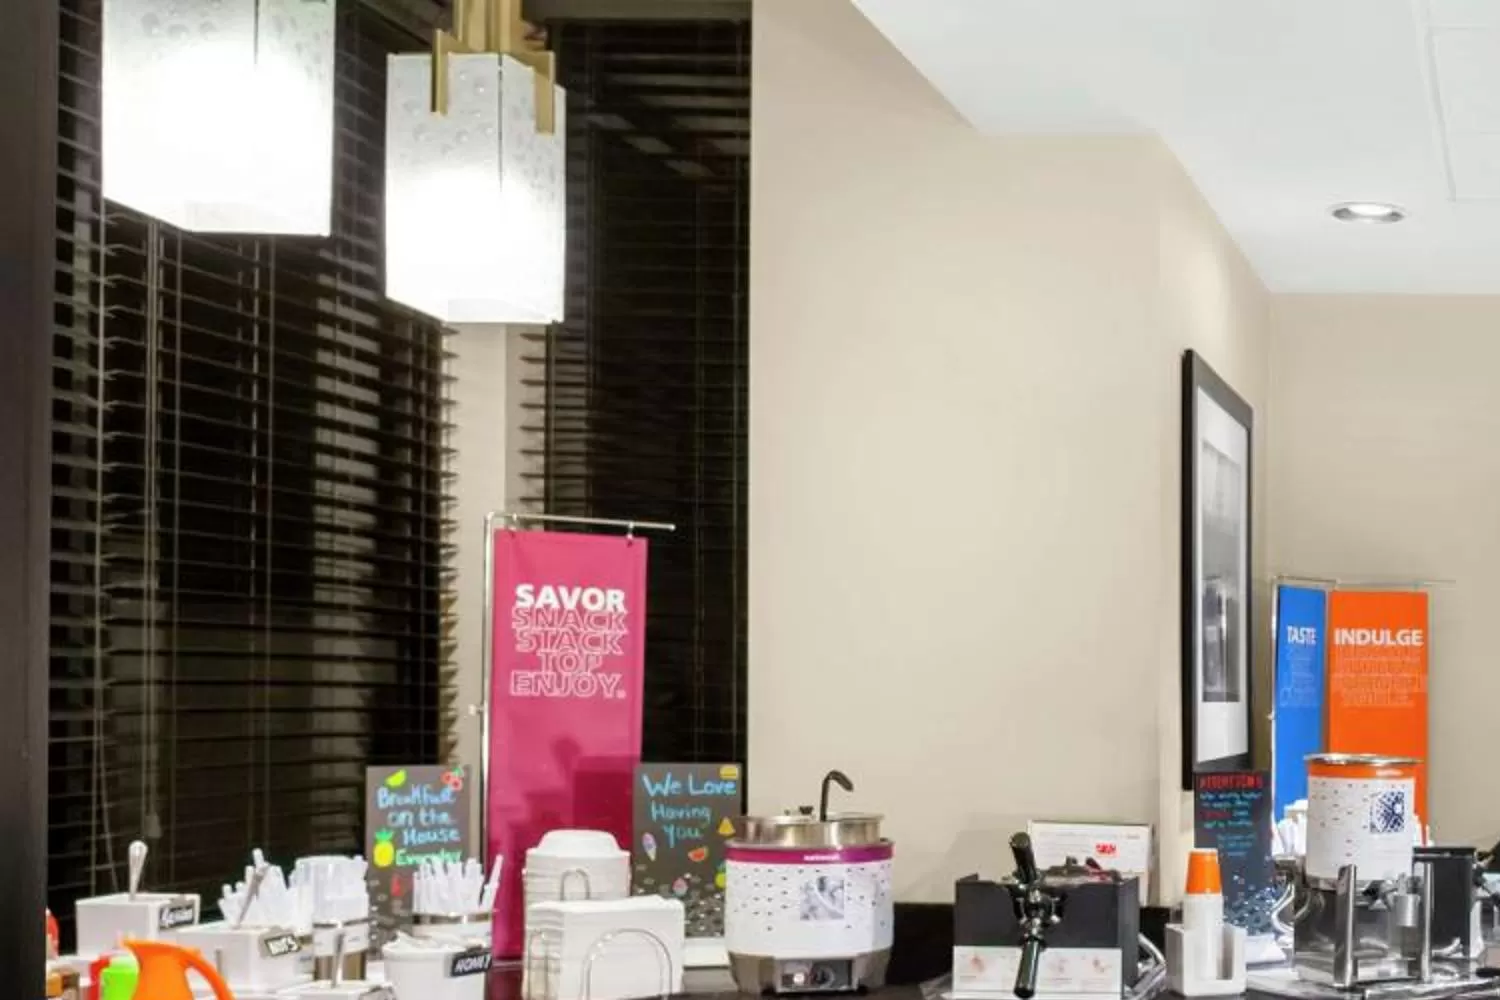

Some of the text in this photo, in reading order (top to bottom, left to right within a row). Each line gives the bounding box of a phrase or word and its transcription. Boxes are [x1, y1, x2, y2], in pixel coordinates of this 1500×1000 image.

[515, 584, 625, 612] SAVOR
[511, 606, 628, 634] SNACK
[515, 627, 625, 655] STACK
[1286, 625, 1317, 645] TASTE
[1334, 628, 1425, 646] INDULGE
[536, 648, 603, 675] TOP
[510, 669, 627, 698] ENJOY.
[642, 772, 736, 797] We Love
[387, 807, 454, 827] on the
[651, 799, 711, 825] Having
[402, 827, 461, 846] House
[662, 823, 704, 848] You
